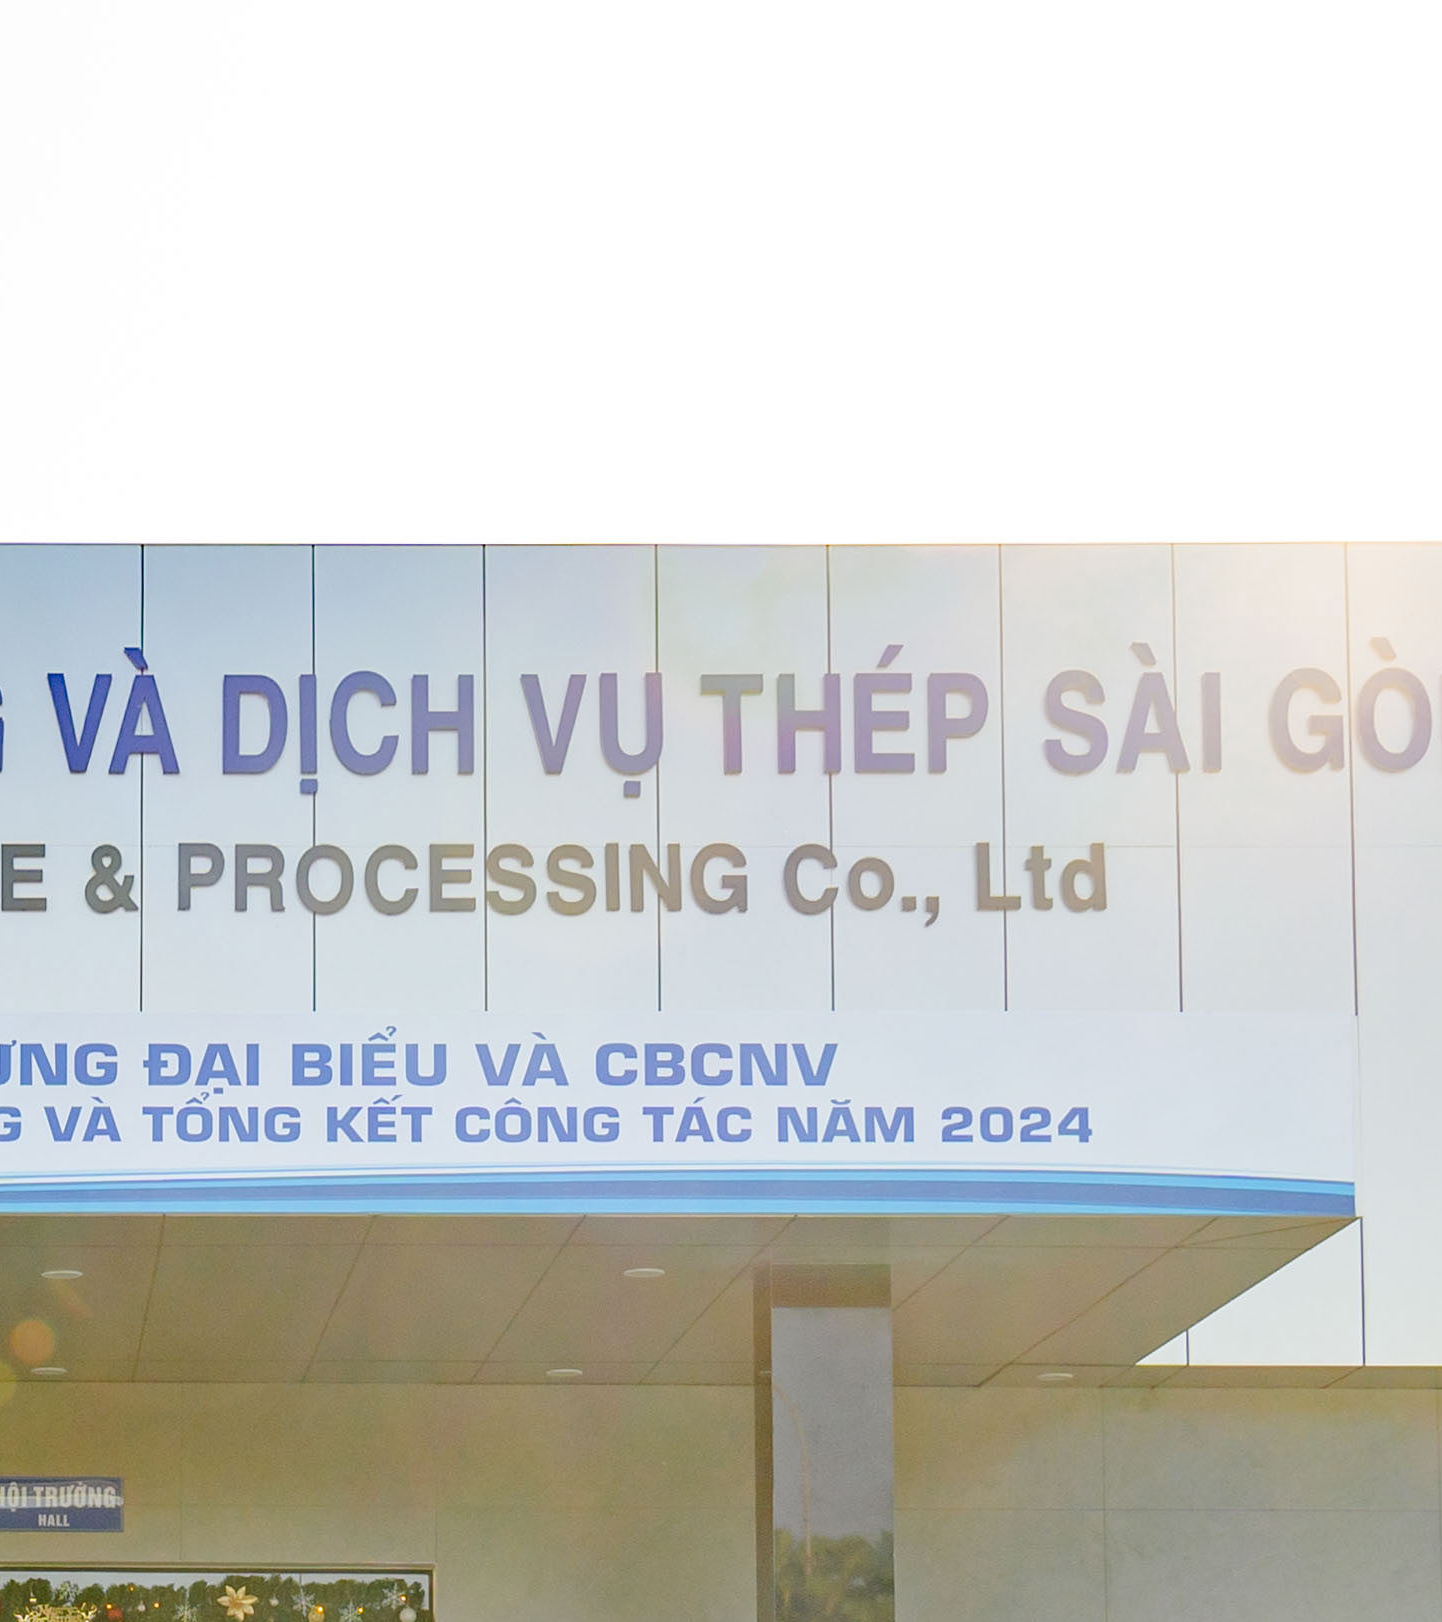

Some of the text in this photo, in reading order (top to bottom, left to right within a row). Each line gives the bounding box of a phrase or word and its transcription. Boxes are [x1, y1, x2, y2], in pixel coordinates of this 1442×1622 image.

[47, 647, 181, 776] VÀ
[222, 671, 476, 797] DỊCH
[521, 672, 664, 799] VỤ
[701, 645, 990, 776] THÉP
[1043, 642, 1222, 776] SÀI
[85, 843, 141, 916] &
[177, 842, 750, 917] PROCESSING
[782, 843, 940, 927] Co.,
[974, 841, 1109, 915] Ltd
[143, 1043, 260, 1095] ĐẠI
[291, 1026, 448, 1087] BIỂU
[475, 1032, 571, 1087] VÀ
[596, 1042, 840, 1087] CBCNV
[44, 1096, 122, 1143] VÀ
[142, 1092, 302, 1143] TỔNG
[325, 1094, 434, 1143] KẾT
[454, 1097, 620, 1143] CÔNG
[642, 1097, 753, 1143] TÁC
[777, 1098, 916, 1143] NĂM
[940, 1105, 1094, 1143] 2024
[37, 1513, 70, 1528] HALL
